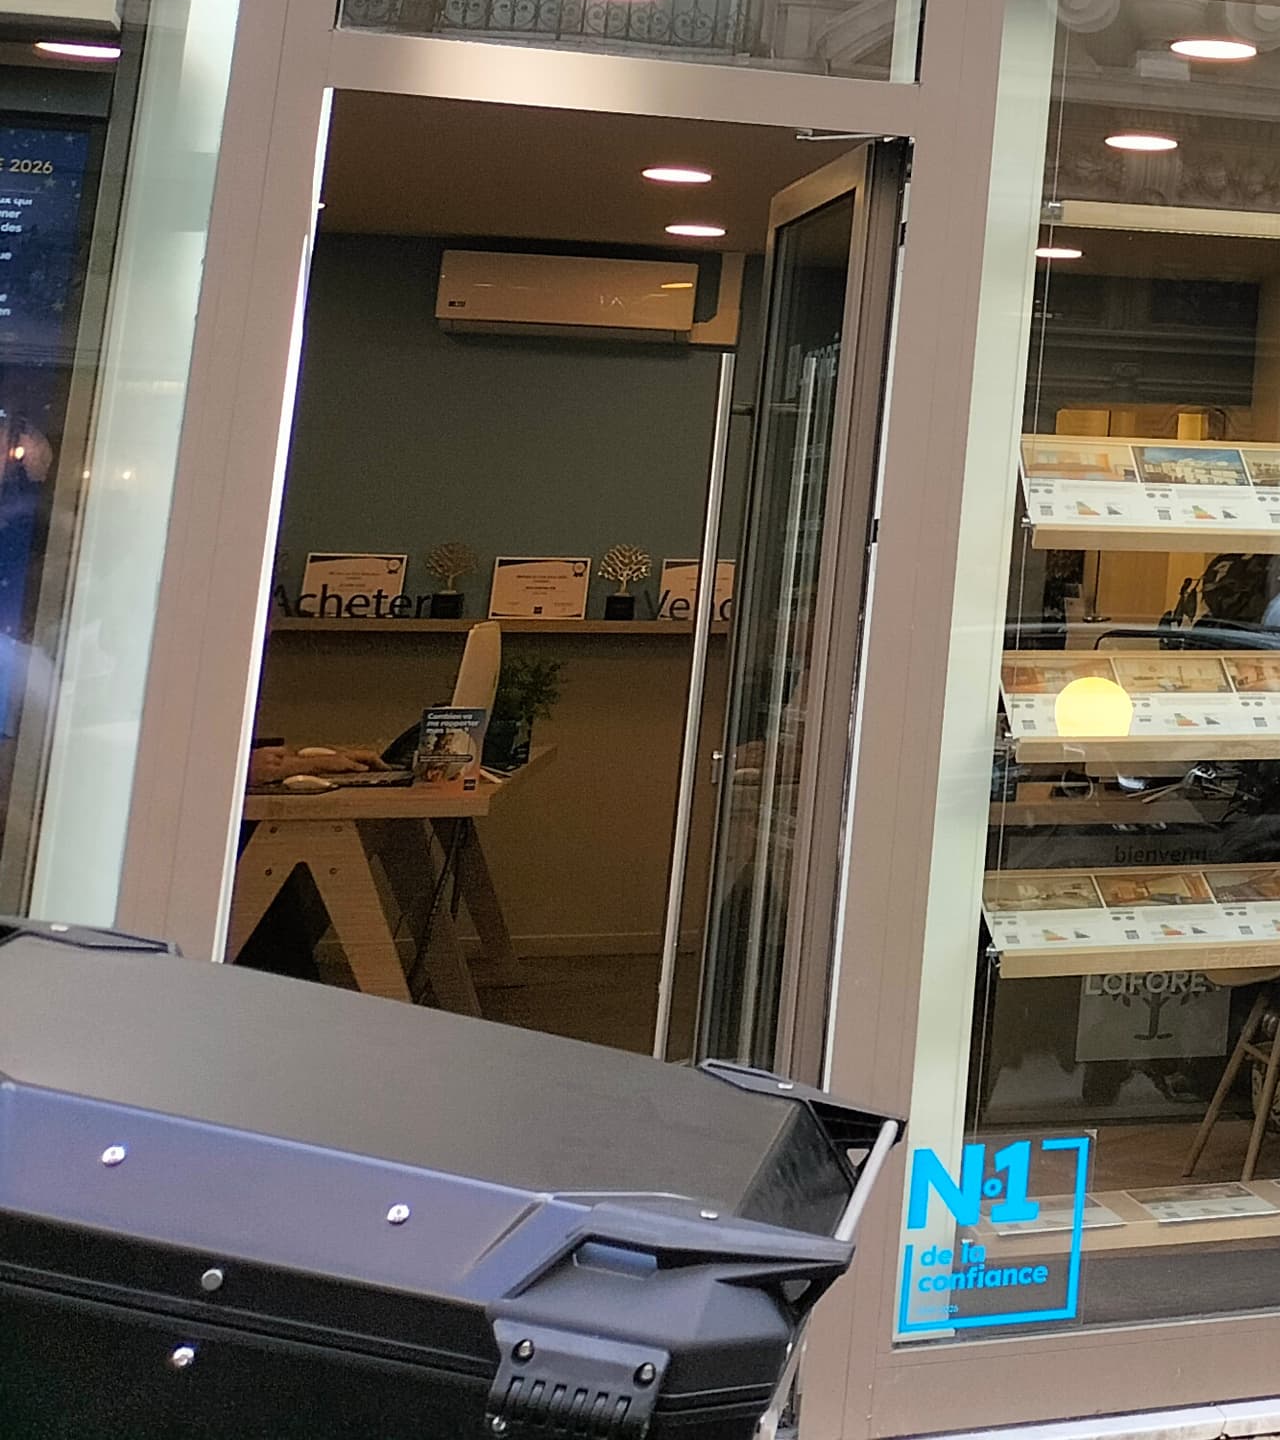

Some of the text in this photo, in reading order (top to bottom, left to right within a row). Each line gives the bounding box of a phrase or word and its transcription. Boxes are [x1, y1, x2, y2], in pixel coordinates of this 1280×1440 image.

[9, 159, 53, 174] 2026
[1, 222, 22, 232] des
[274, 584, 431, 618] Acheter
[921, 1243, 986, 1266] de la
[918, 1264, 1049, 1292] confiance
